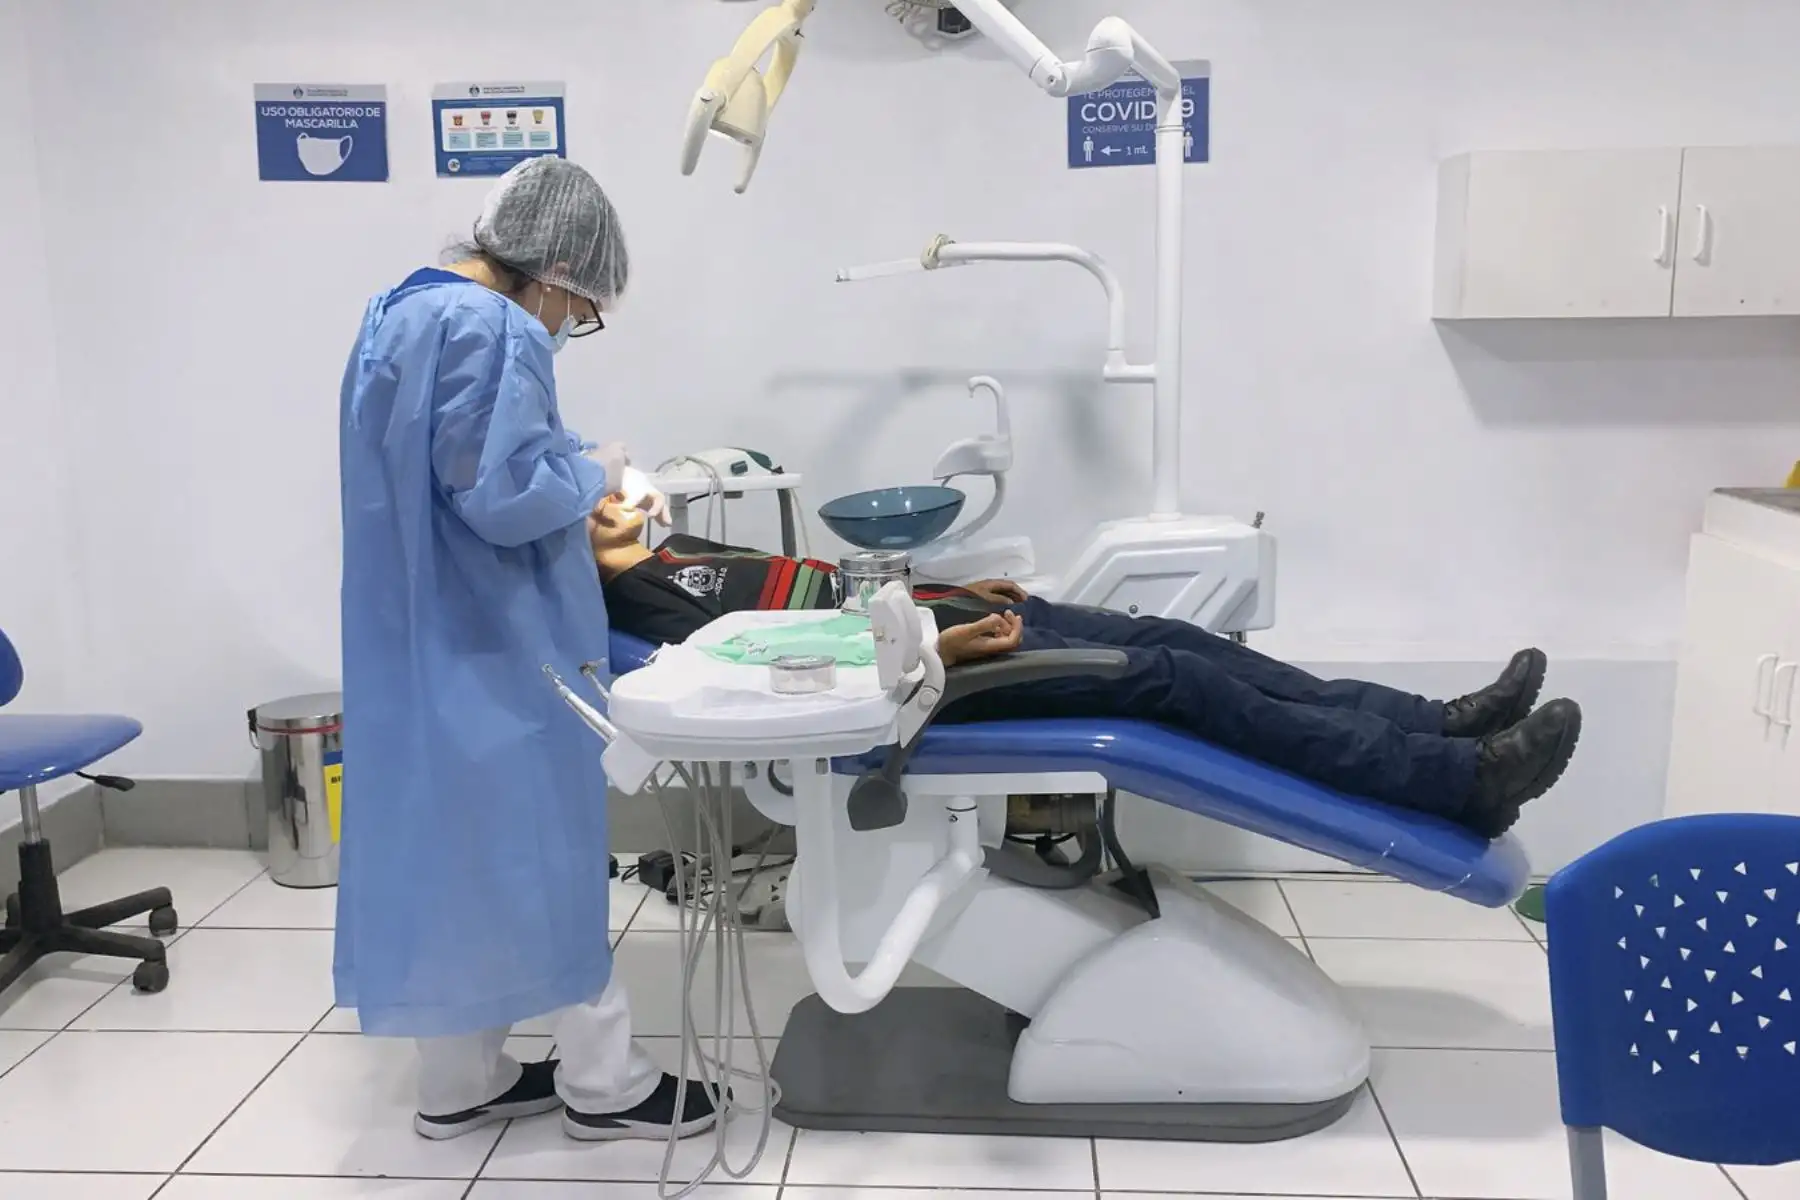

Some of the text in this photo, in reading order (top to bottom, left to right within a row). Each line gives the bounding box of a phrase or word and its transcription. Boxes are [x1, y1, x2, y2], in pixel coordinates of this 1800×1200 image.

[1098, 87, 1157, 99] PROTEGEM
[261, 106, 381, 117] USO OBLIGATORIO DE
[1081, 99, 1195, 122] COVID9
[285, 119, 359, 129] MASCARILLA
[1082, 124, 1129, 134] CONSERVE
[1131, 123, 1144, 132] SU
[1125, 145, 1132, 156] 1
